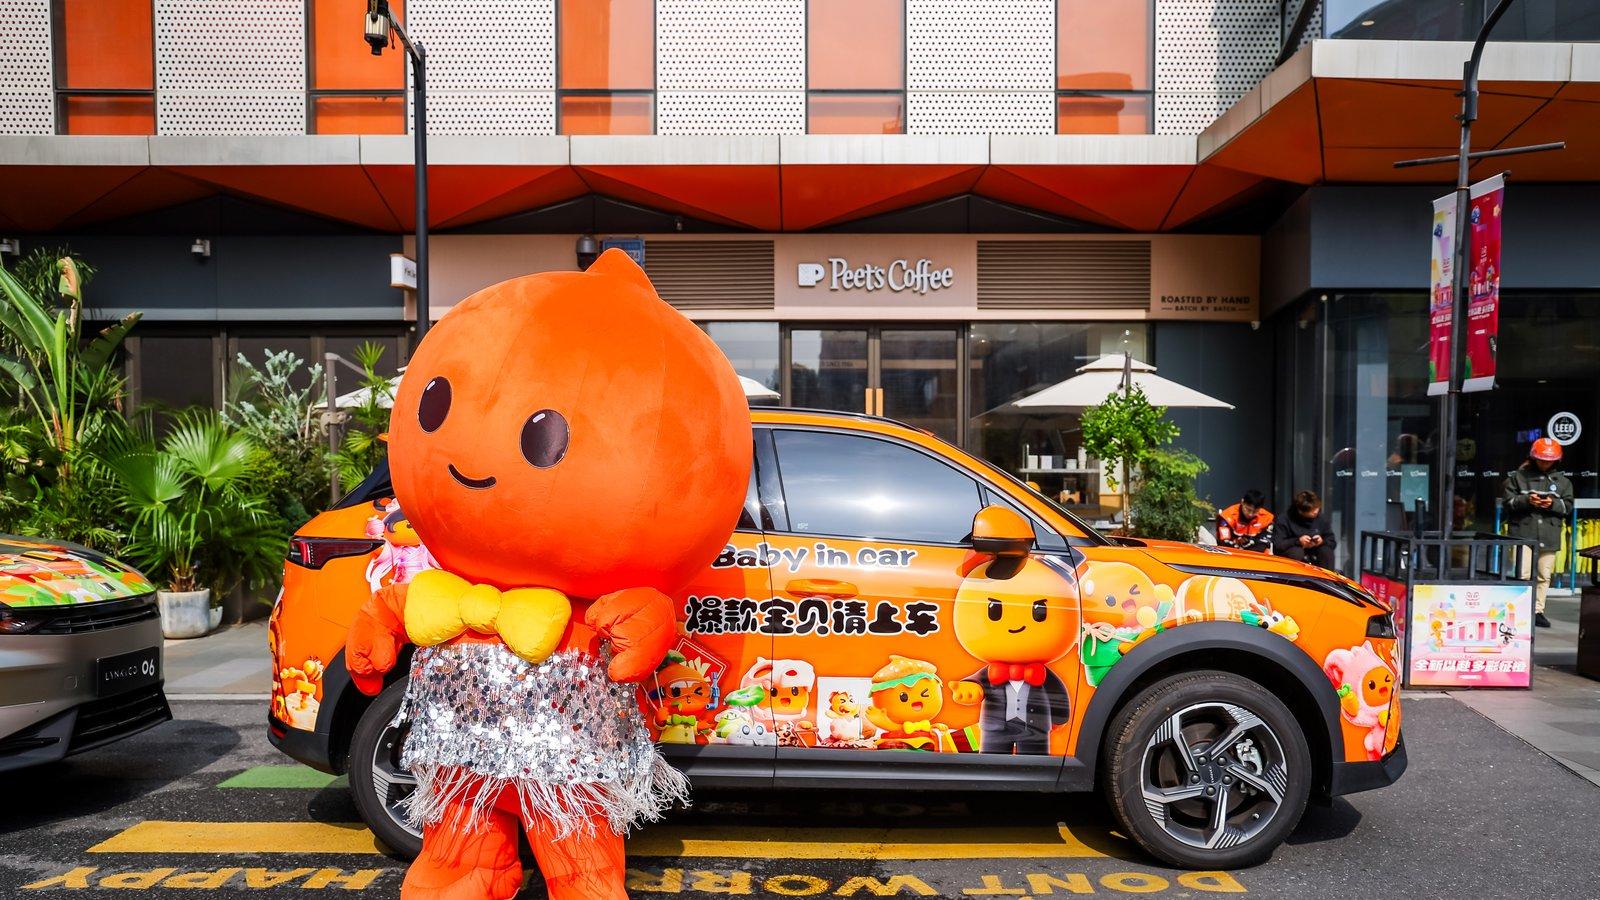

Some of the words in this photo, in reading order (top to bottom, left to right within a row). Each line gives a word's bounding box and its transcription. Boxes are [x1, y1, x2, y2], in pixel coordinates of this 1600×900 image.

[828, 257, 886, 291] Peet's
[887, 258, 954, 295] Coffee
[1160, 295, 1203, 305] ROASTED
[1206, 295, 1218, 305] BY
[1221, 295, 1251, 305] HAND
[1174, 305, 1198, 313] BATCH
[1200, 305, 1210, 313] BY
[1213, 305, 1236, 313] BATCH
[1554, 423, 1574, 433] LEED
[711, 543, 806, 573] Baby
[814, 543, 851, 568] in
[856, 548, 917, 568] car
[684, 595, 941, 636] 爆款宝贝请上车
[141, 658, 155, 676] 06
[20, 867, 383, 890] HAPPY
